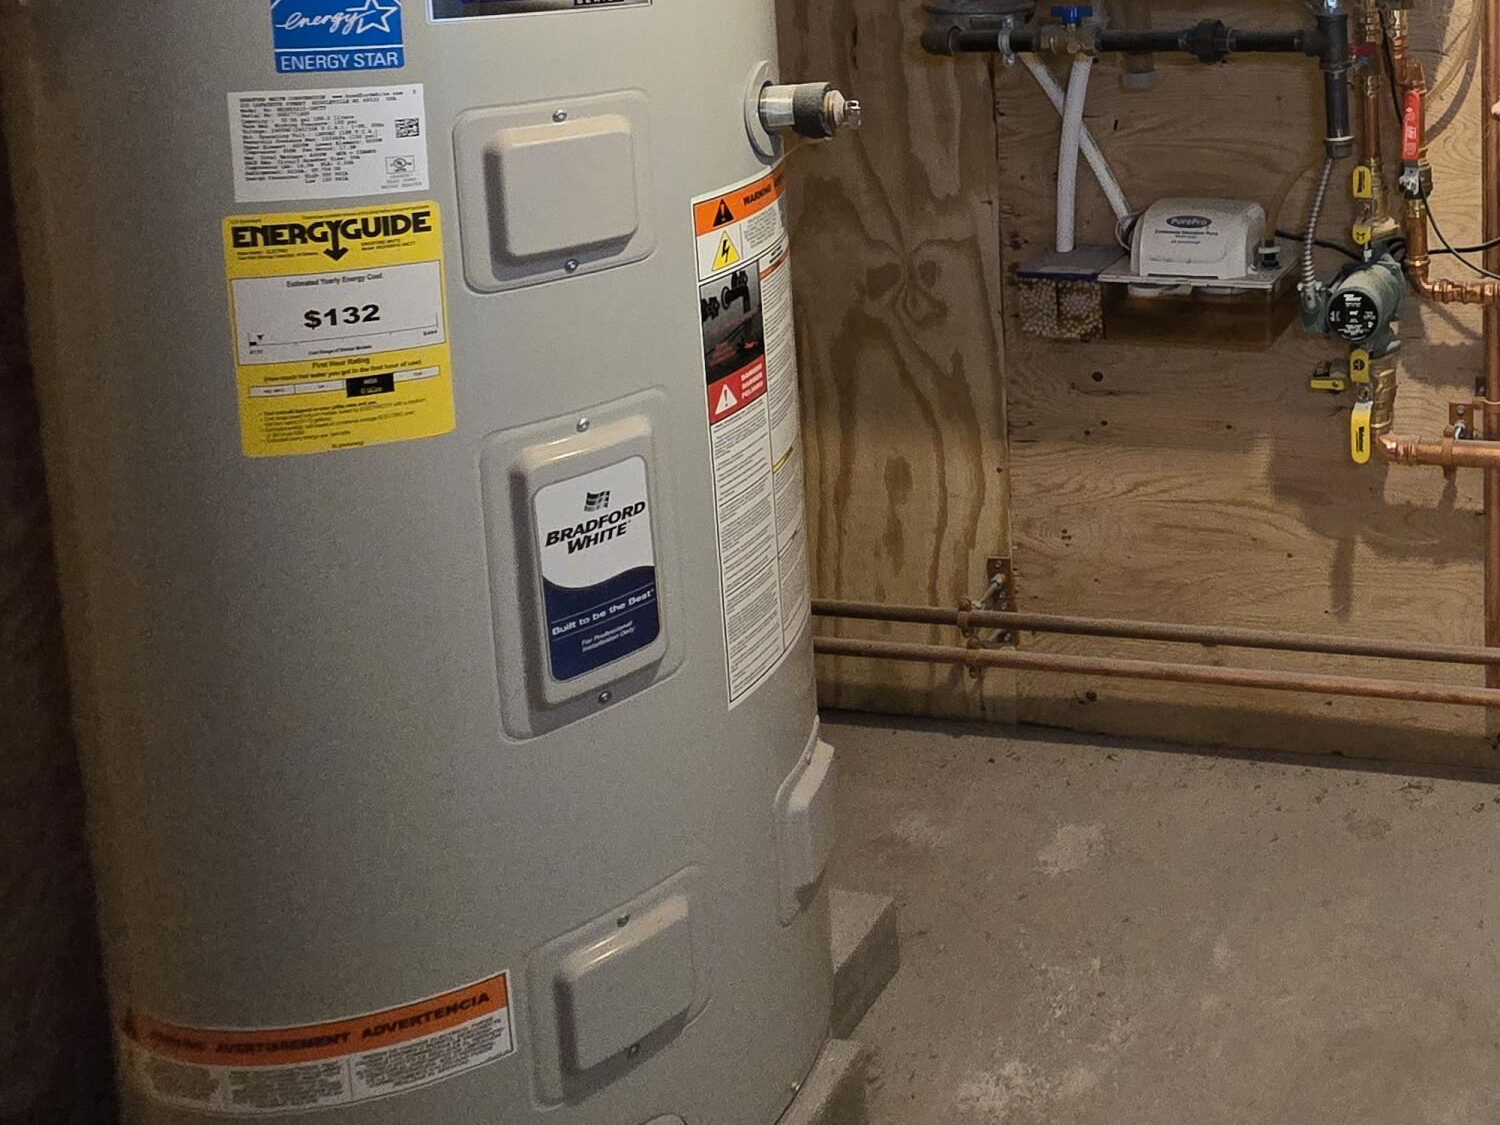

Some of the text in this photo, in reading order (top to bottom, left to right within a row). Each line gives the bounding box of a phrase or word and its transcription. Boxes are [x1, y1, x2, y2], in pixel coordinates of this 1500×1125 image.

[276, 7, 362, 34] energy
[280, 51, 399, 71] ENERGY STAR
[232, 211, 431, 251] ENERGYGUIDE
[303, 304, 381, 330] $132
[545, 501, 646, 548] BRADFORD
[567, 523, 627, 555] WHITE
[551, 589, 654, 636] Built to be the Best
[361, 991, 491, 1040] ADVERTENCIA
